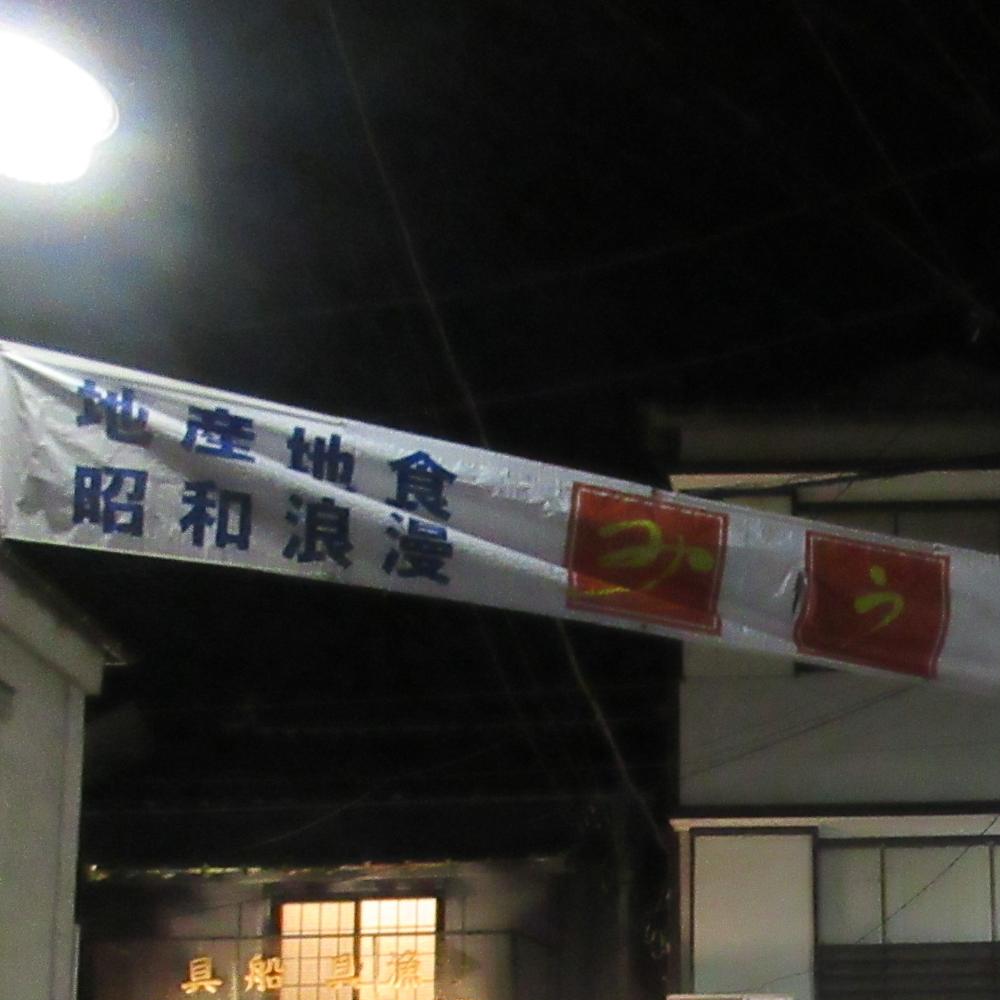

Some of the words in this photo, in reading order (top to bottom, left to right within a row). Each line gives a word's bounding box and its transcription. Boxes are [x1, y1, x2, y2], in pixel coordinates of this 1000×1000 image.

[76, 378, 456, 518] 地産地食
[73, 465, 454, 585] 昭和浪漫
